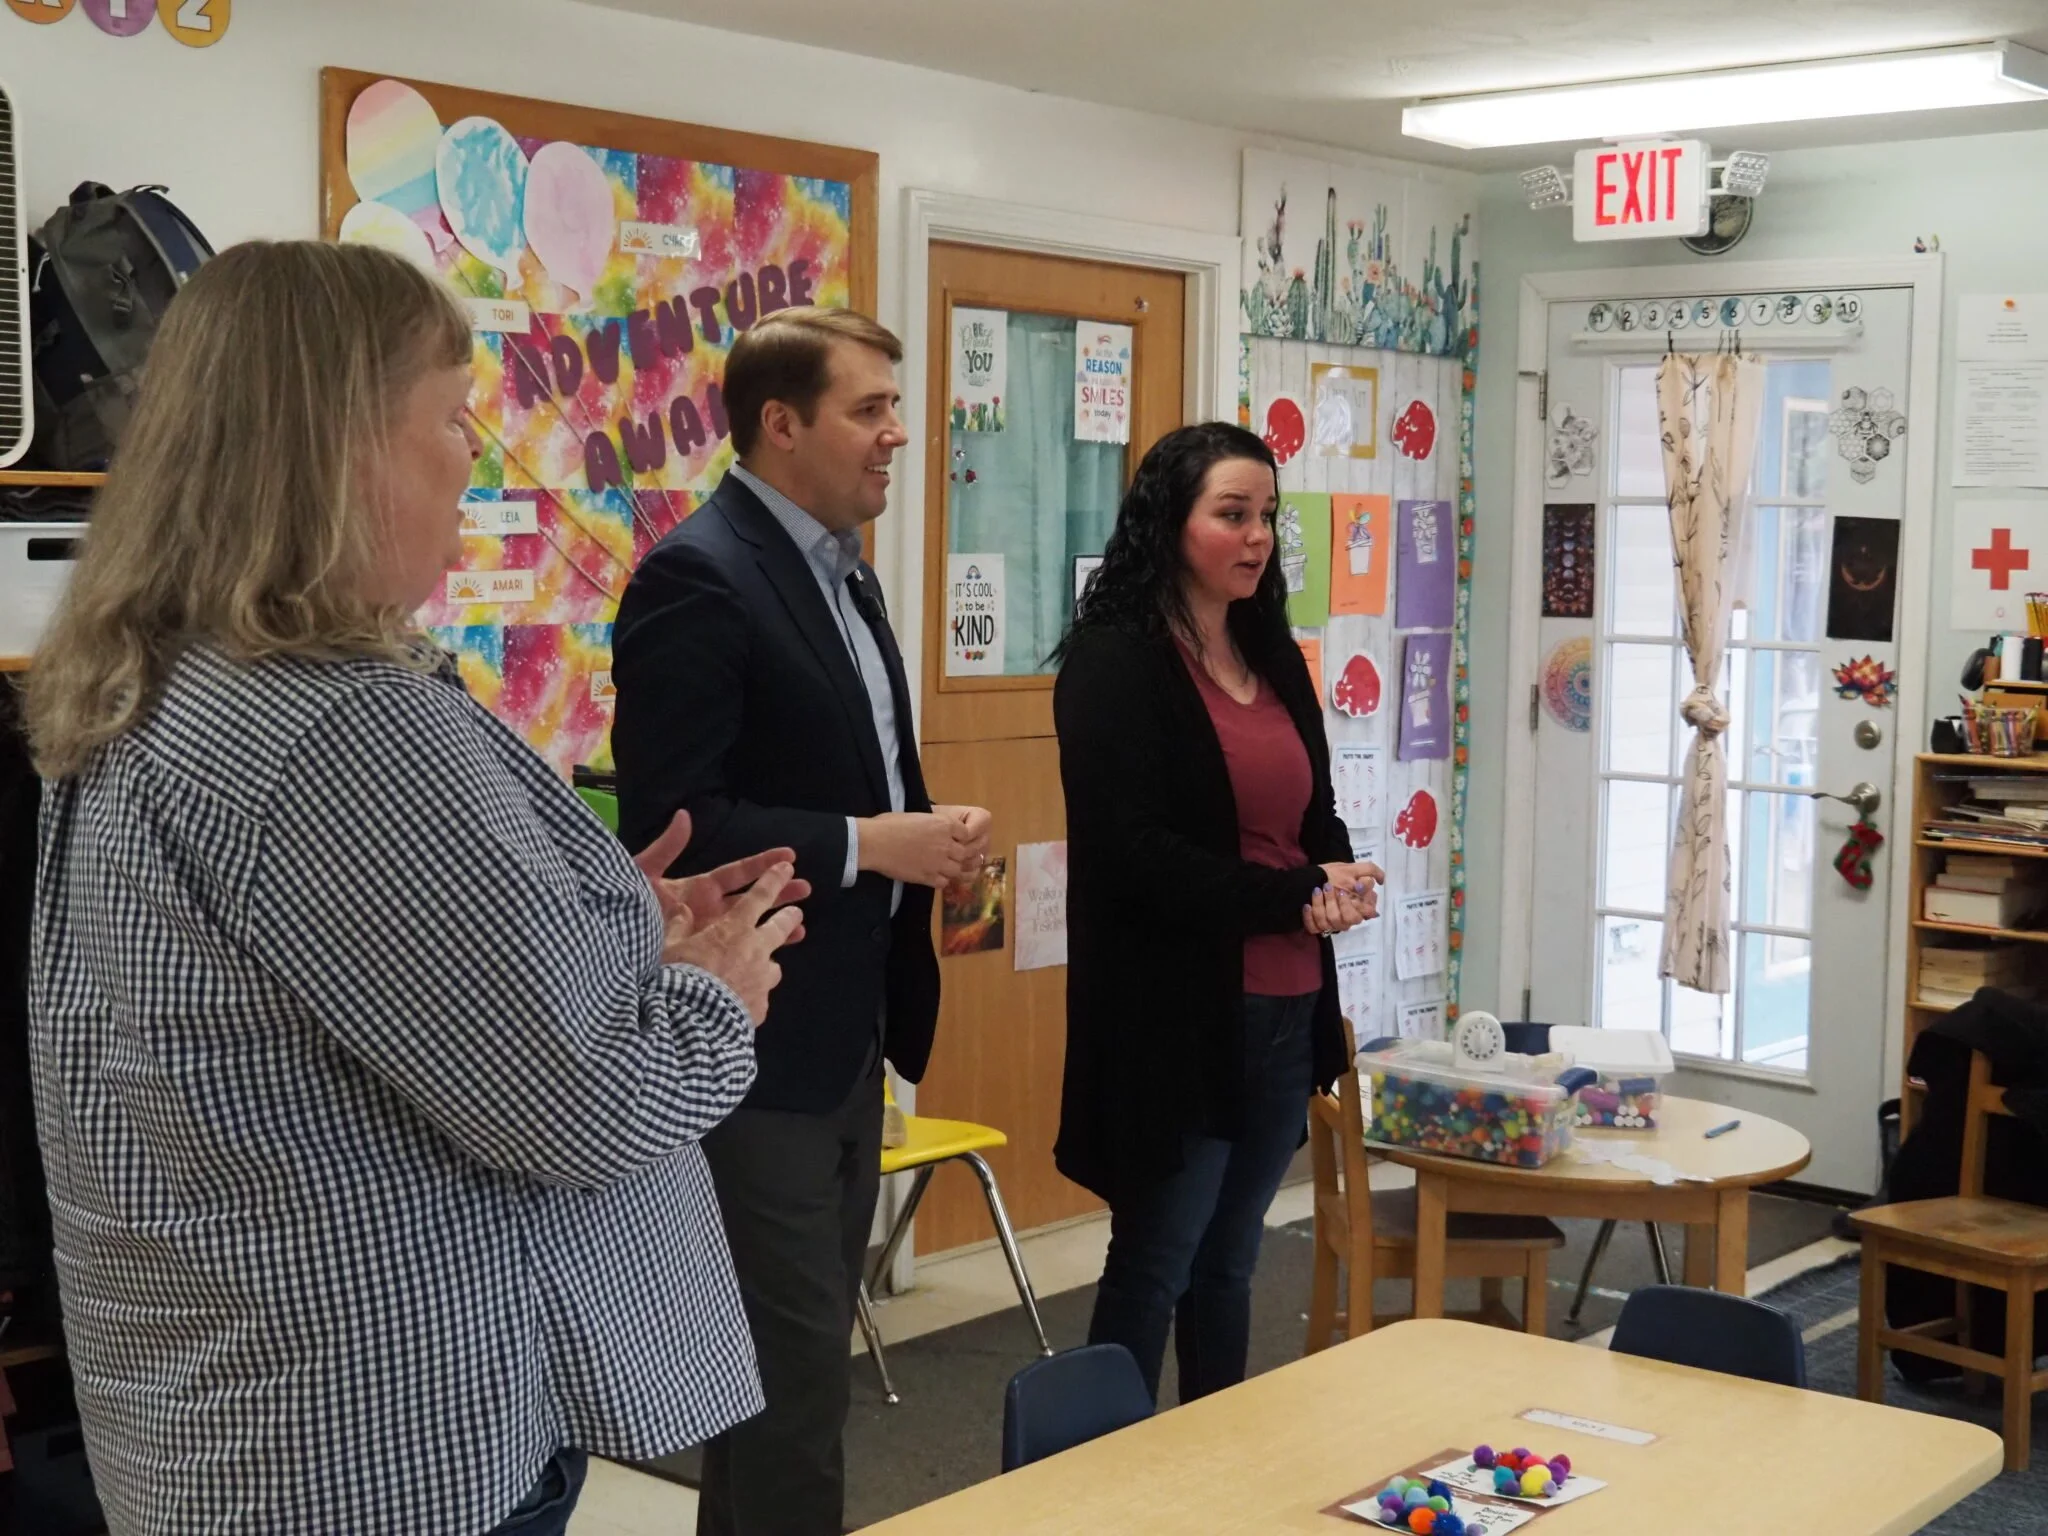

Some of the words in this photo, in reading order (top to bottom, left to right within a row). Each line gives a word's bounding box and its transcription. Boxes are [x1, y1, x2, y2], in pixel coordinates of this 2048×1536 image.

[1594, 148, 1682, 226] EXIT
[492, 308, 514, 321] TORI
[1623, 311, 1631, 323] 2
[1648, 310, 1657, 322] 3
[1674, 308, 1683, 320] 4
[1702, 307, 1710, 319] 5
[1729, 307, 1737, 318] 6
[1758, 304, 1766, 317] 7
[1785, 303, 1794, 316] 8
[1813, 304, 1822, 316] 9
[1841, 301, 1858, 314] 10
[514, 259, 814, 410] ADVENTURE
[965, 350, 993, 373] YOU
[1086, 358, 1123, 375] REASON
[1081, 386, 1125, 407] SMILES
[1094, 409, 1112, 421] today
[500, 511, 521, 524] LEIA
[493, 579, 523, 592] AMARI
[955, 583, 971, 598] IT'S
[973, 583, 994, 598] COOL
[965, 602, 973, 611] to
[975, 602, 985, 611] be
[955, 615, 994, 647] KIND
